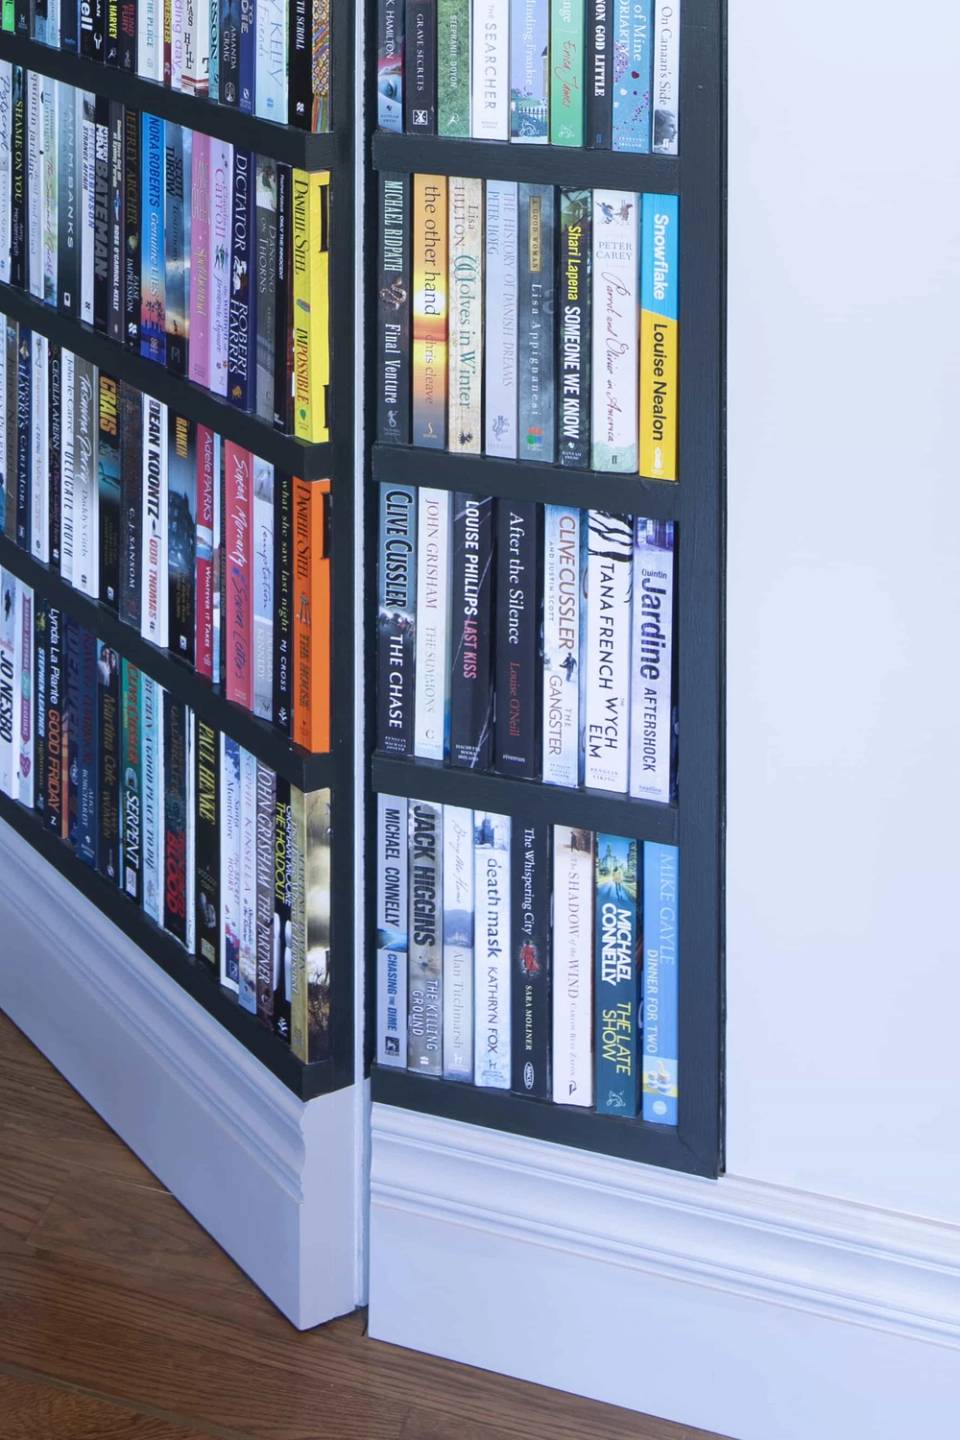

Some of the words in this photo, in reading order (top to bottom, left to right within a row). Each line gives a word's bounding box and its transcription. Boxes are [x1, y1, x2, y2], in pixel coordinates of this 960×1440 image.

[595, 25, 606, 50] GOD
[594, 55, 605, 96] LITTLE
[149, 117, 160, 151] NORA
[149, 153, 160, 207] ROBERTS
[234, 153, 247, 251] DICTATOR
[425, 186, 439, 215] the
[425, 219, 439, 266] other
[568, 226, 581, 256] Shari
[653, 214, 669, 300] Snowflake
[425, 271, 439, 315] hand
[566, 259, 580, 300] Lapena
[229, 298, 239, 373] HARRIS
[385, 323, 400, 353] Final
[564, 306, 580, 369] SOMEONE
[653, 323, 667, 377] Louise
[296, 328, 309, 403] IMPOSSIBLE
[385, 360, 400, 403] Venture
[564, 374, 579, 394] WE
[148, 400, 160, 447] DEAN
[564, 398, 579, 438] KNOW
[653, 381, 666, 440] Nealon
[148, 451, 160, 518] KOONTZ
[465, 500, 479, 548] LOUISE
[509, 513, 523, 554] After
[464, 554, 478, 615] PHILLIPS
[509, 558, 523, 583] the
[600, 563, 614, 610] TANA
[464, 620, 477, 648] LAST
[509, 588, 522, 644] Silence
[640, 577, 667, 680] Jardine
[0, 651, 13, 681] JO
[389, 635, 403, 665] THE
[464, 652, 476, 679] KISS
[599, 616, 613, 689] FRENCH
[389, 672, 403, 728] CHASE
[48, 710, 60, 749] GOOD
[643, 688, 657, 772] AFTERSHOCK
[47, 753, 60, 812] FRIDAY
[125, 791, 138, 868] SERPENT
[385, 808, 400, 860] MICHAEL
[414, 806, 433, 859] JACK
[524, 828, 534, 846] The
[385, 867, 400, 927] CONNELLY
[487, 858, 501, 906] death
[522, 850, 534, 909] Whispering
[414, 865, 435, 946] HIGGINS
[523, 912, 534, 934] City
[487, 912, 501, 958] mask
[601, 903, 616, 986] CONNELLY
[617, 909, 631, 982] MICHAEL
